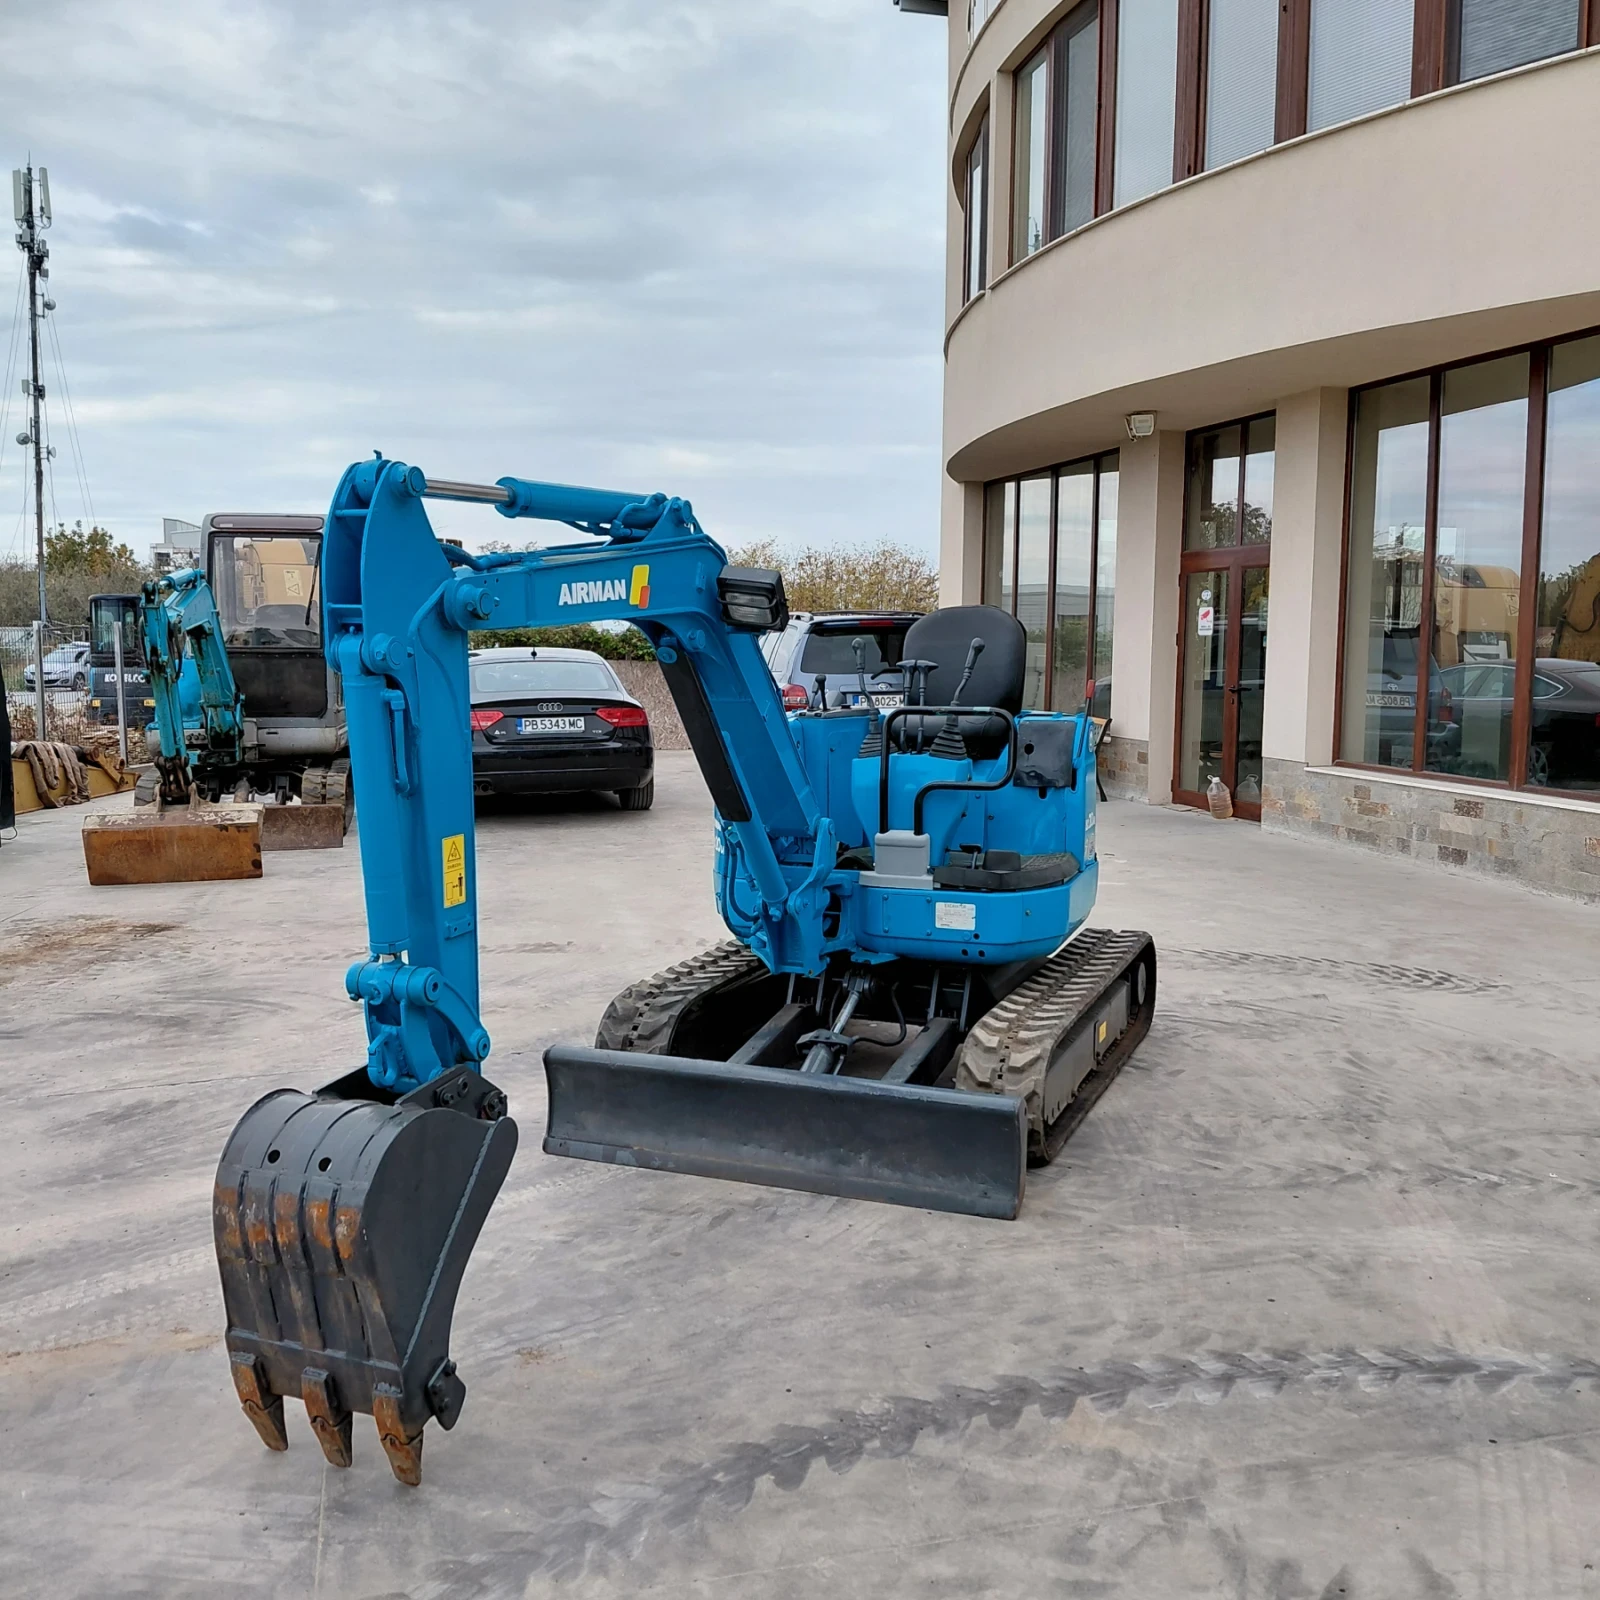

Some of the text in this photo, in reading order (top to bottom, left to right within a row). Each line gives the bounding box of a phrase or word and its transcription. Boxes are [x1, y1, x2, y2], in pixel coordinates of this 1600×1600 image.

[558, 579, 626, 606] AIRMAN
[104, 673, 146, 683] KOELCO
[874, 696, 898, 706] 8025
[540, 719, 567, 730] 5343
[568, 718, 583, 729] MC
